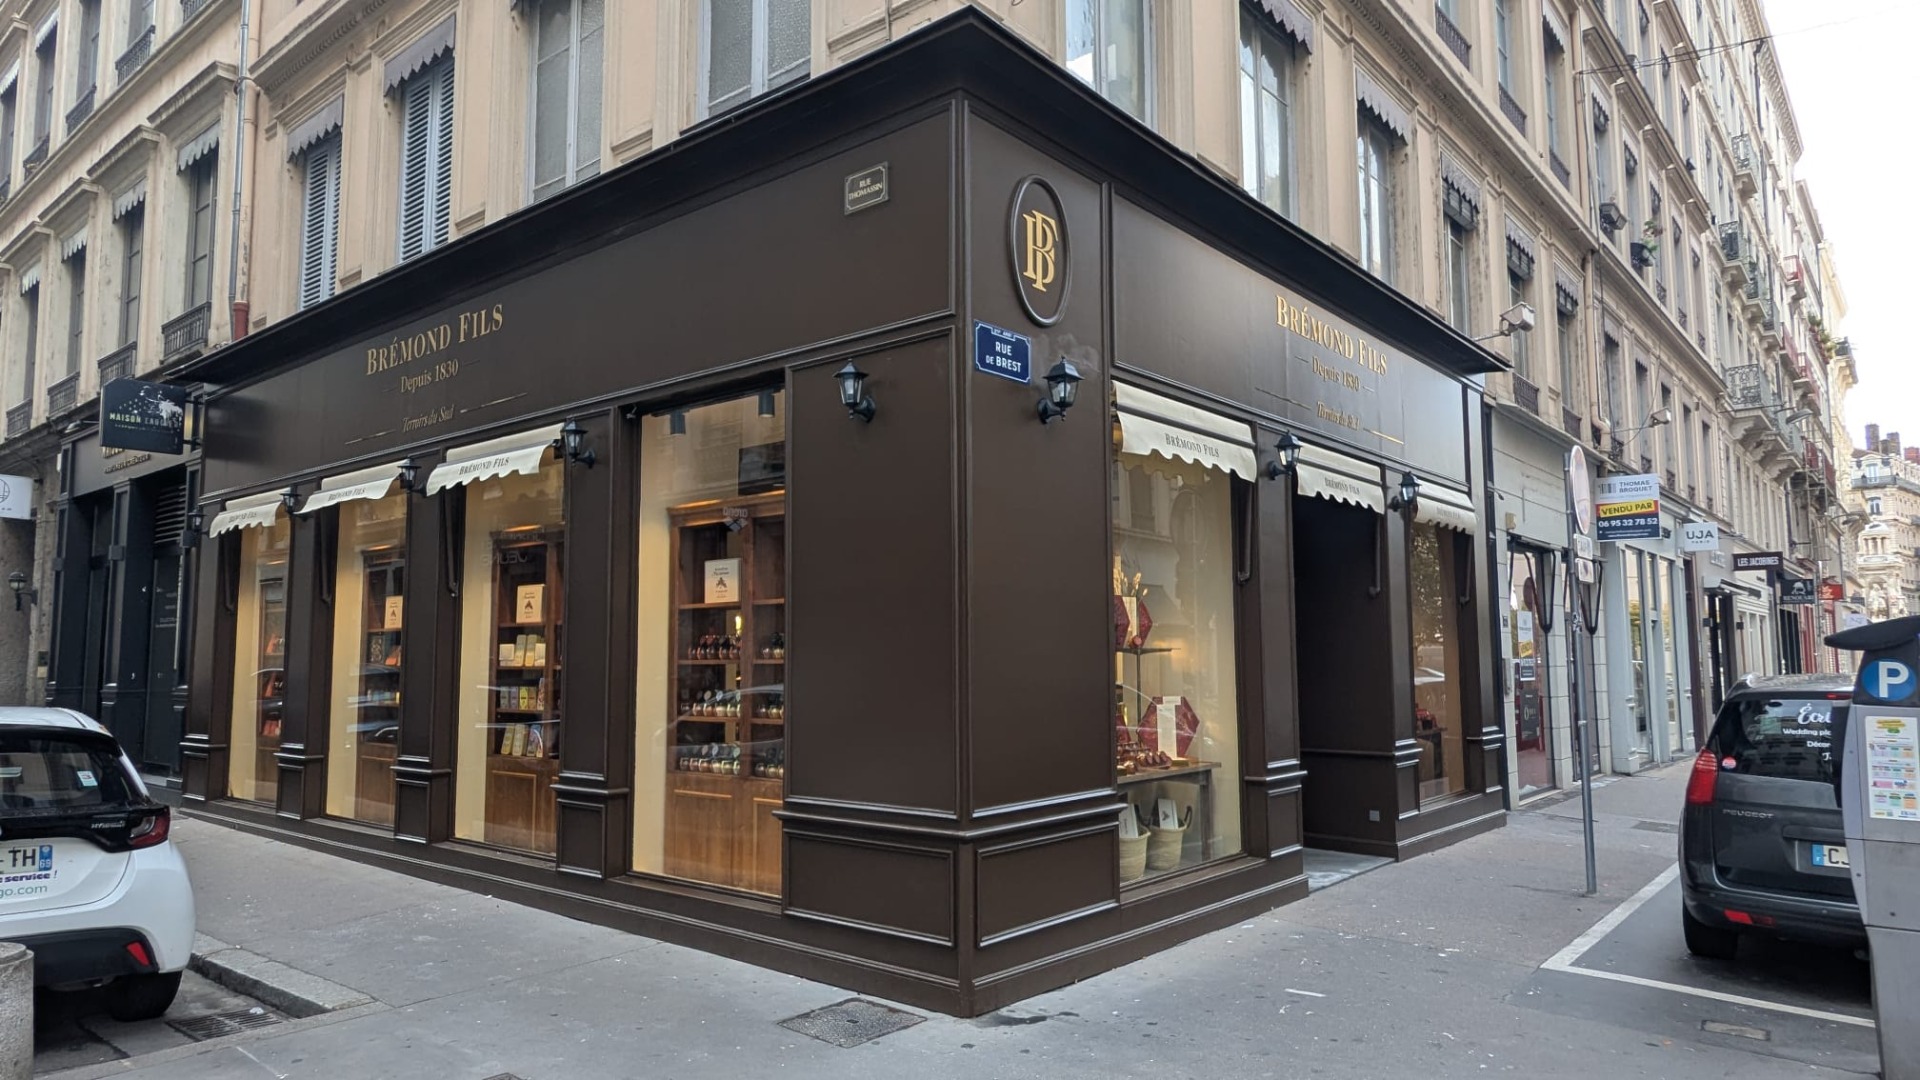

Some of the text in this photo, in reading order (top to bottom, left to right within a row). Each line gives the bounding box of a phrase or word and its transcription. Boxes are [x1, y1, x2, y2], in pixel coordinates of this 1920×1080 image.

[859, 177, 872, 188] RUE
[848, 182, 883, 200] THOMASSIN
[366, 304, 503, 375] BRÉMOND FILS
[1276, 294, 1388, 376] BRÉMOND FILS
[995, 341, 1012, 356] RUE
[985, 354, 1021, 373] DE BREST
[401, 359, 459, 393] Depuis 1830
[1312, 355, 1361, 392] Depuis 1830
[109, 412, 141, 423] MAISON
[402, 403, 455, 433] Terroirs du Sud
[1165, 432, 1220, 458] BRÉMOND FILS
[459, 457, 510, 475] BRÉMOND FILS
[1601, 502, 1653, 515] VENDU PAR
[1610, 519, 1621, 527] 95
[1647, 517, 1658, 525] 52
[1686, 529, 1714, 540] UJA
[1737, 557, 1749, 567] LES
[1749, 556, 1779, 566] JACOBINES
[1879, 661, 1909, 698] P
[1783, 728, 1818, 736] Wedding
[1722, 808, 1774, 819] PEUGEOT
[39, 859, 52, 869] 69
[4, 872, 51, 883] service
